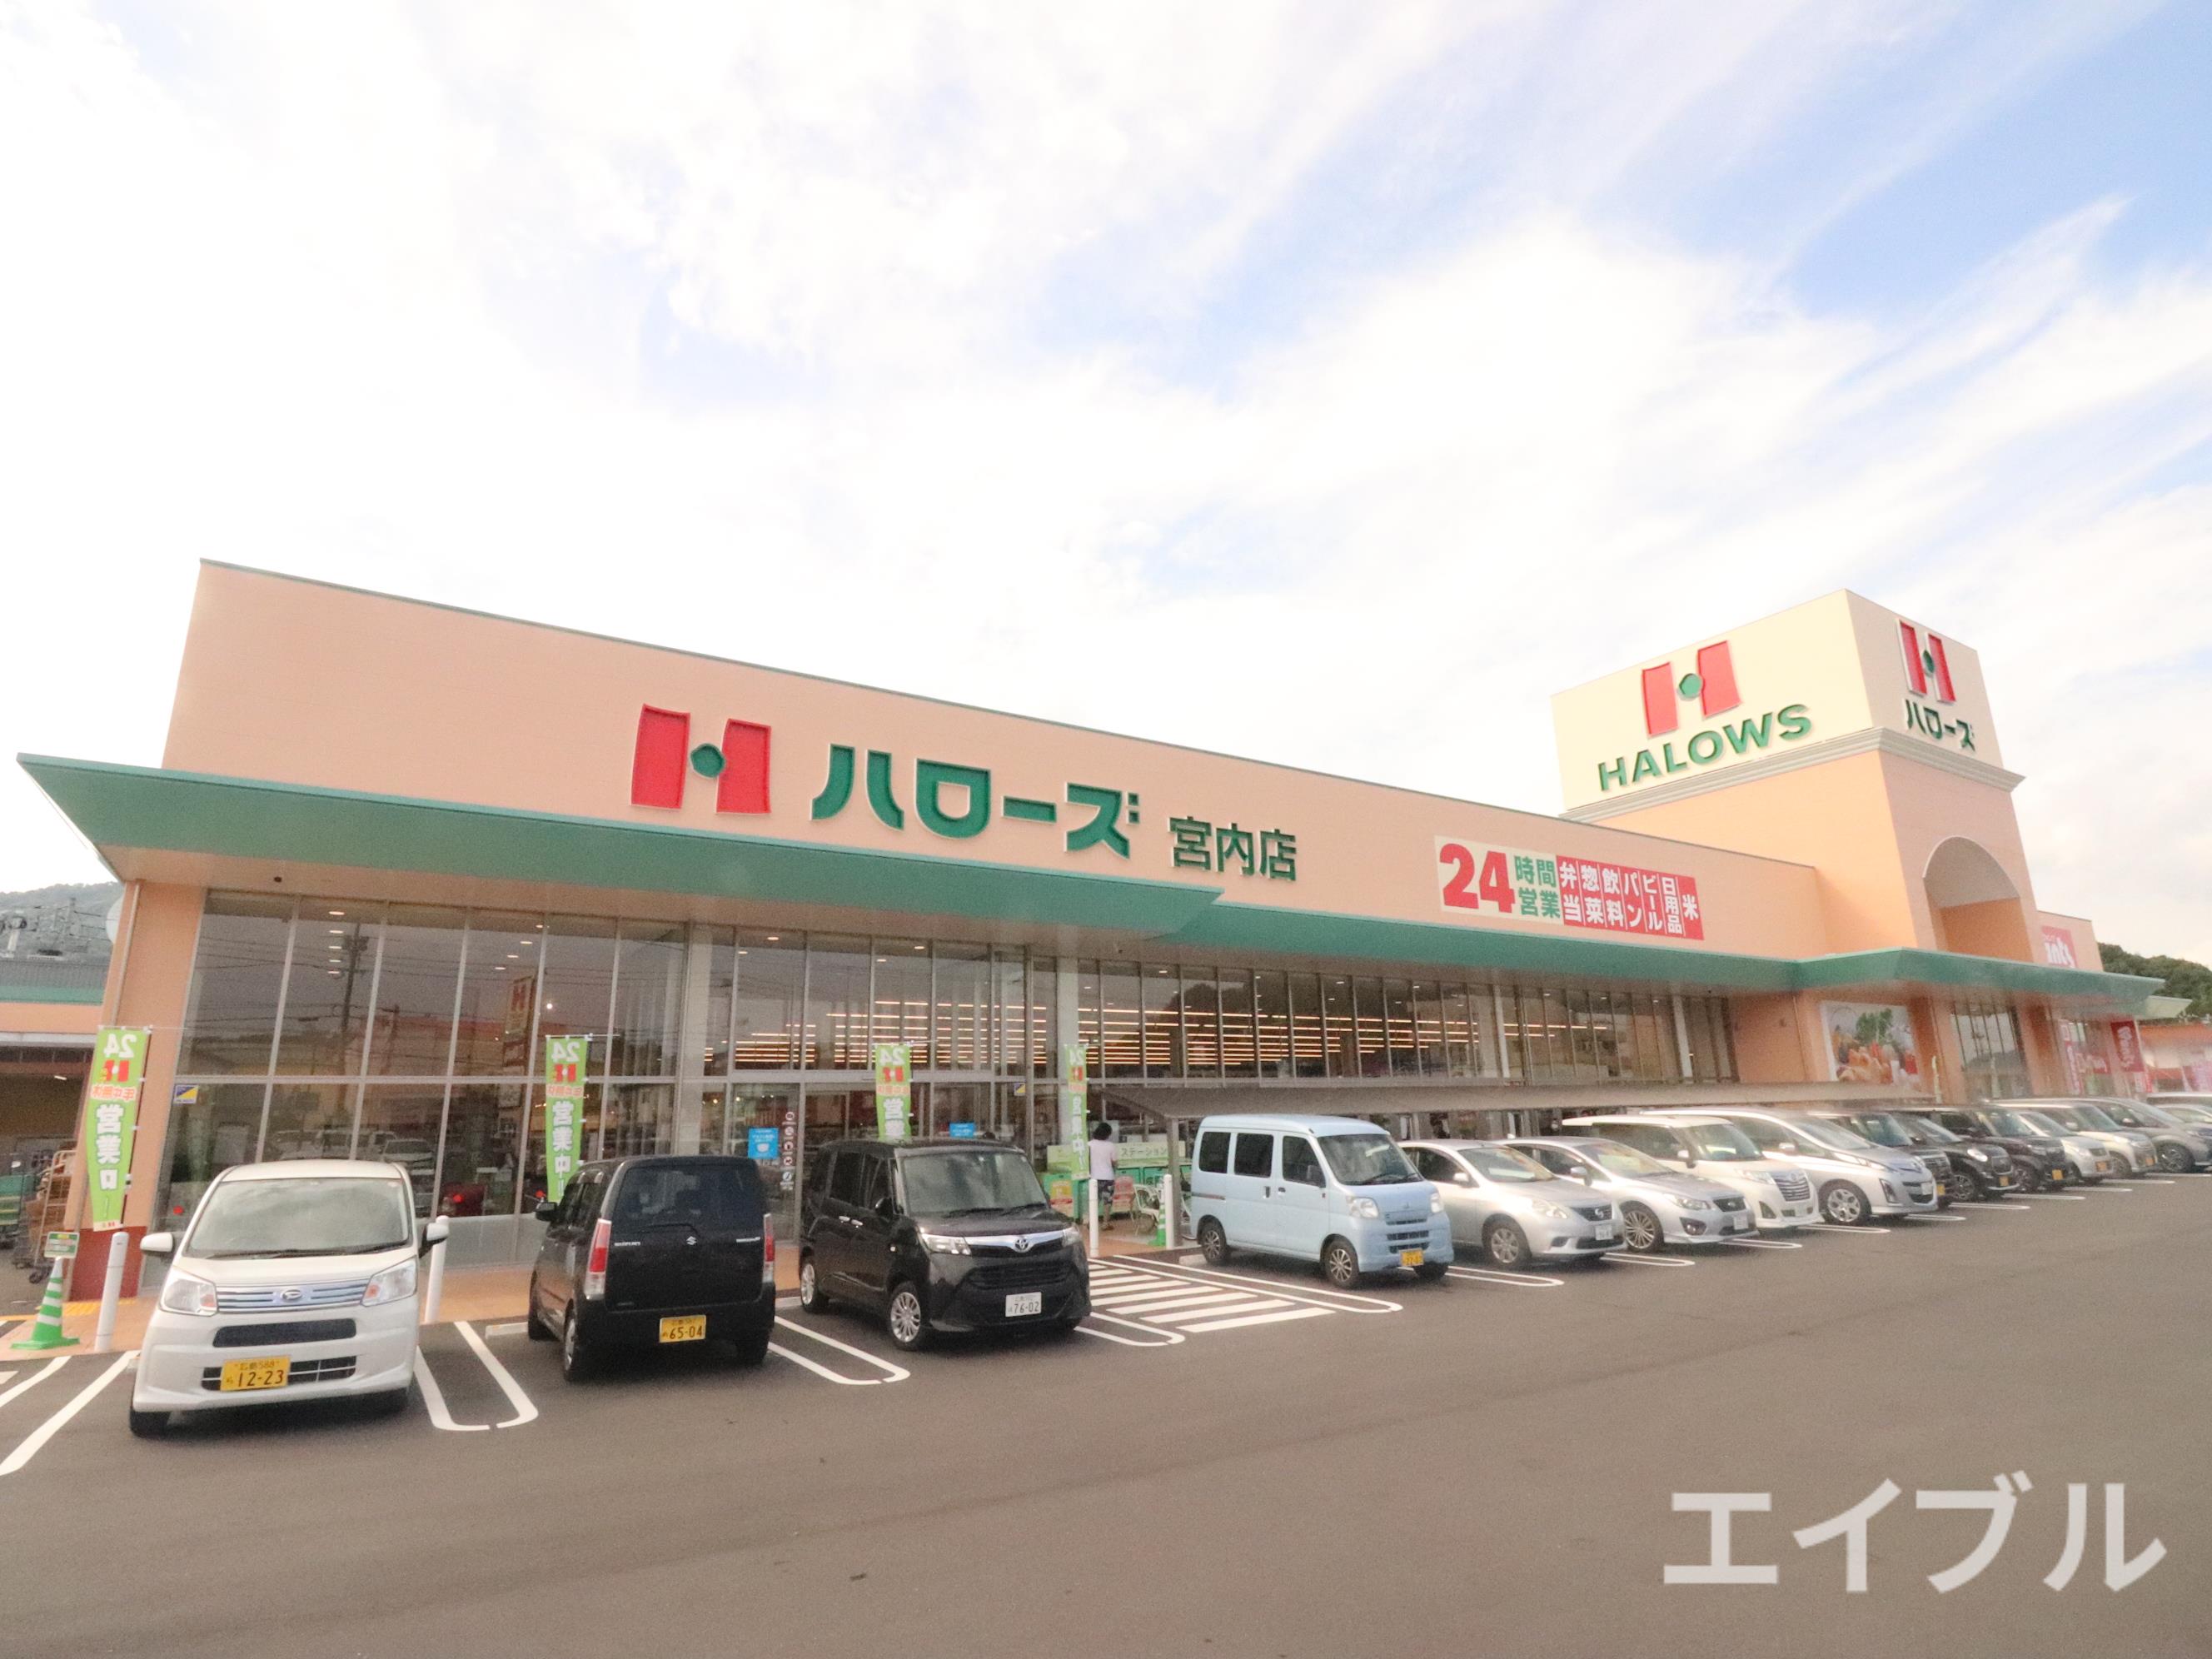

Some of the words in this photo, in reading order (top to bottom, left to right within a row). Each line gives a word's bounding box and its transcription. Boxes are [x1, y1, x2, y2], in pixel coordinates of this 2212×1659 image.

[1597, 703, 1814, 792] HALOWS
[1904, 698, 1976, 752] ハローズ
[810, 741, 1140, 860] ハローズ
[1168, 815, 1298, 881] 宮内店
[1439, 843, 1516, 914] 24
[1514, 854, 1557, 889] 時間
[1559, 861, 1582, 923] 弁当
[1582, 864, 1604, 924] 惣菜
[1602, 868, 1624, 928] 飲料
[1518, 887, 1561, 919] 営業
[1623, 872, 1643, 928] パン
[1642, 874, 1664, 931] ビール
[1661, 877, 1684, 934] 日用品
[1681, 894, 1700, 920] 米
[669, 1325, 702, 1339] 65-04
[1014, 1301, 1039, 1313] 76-02
[238, 1369, 284, 1387] 12-23
